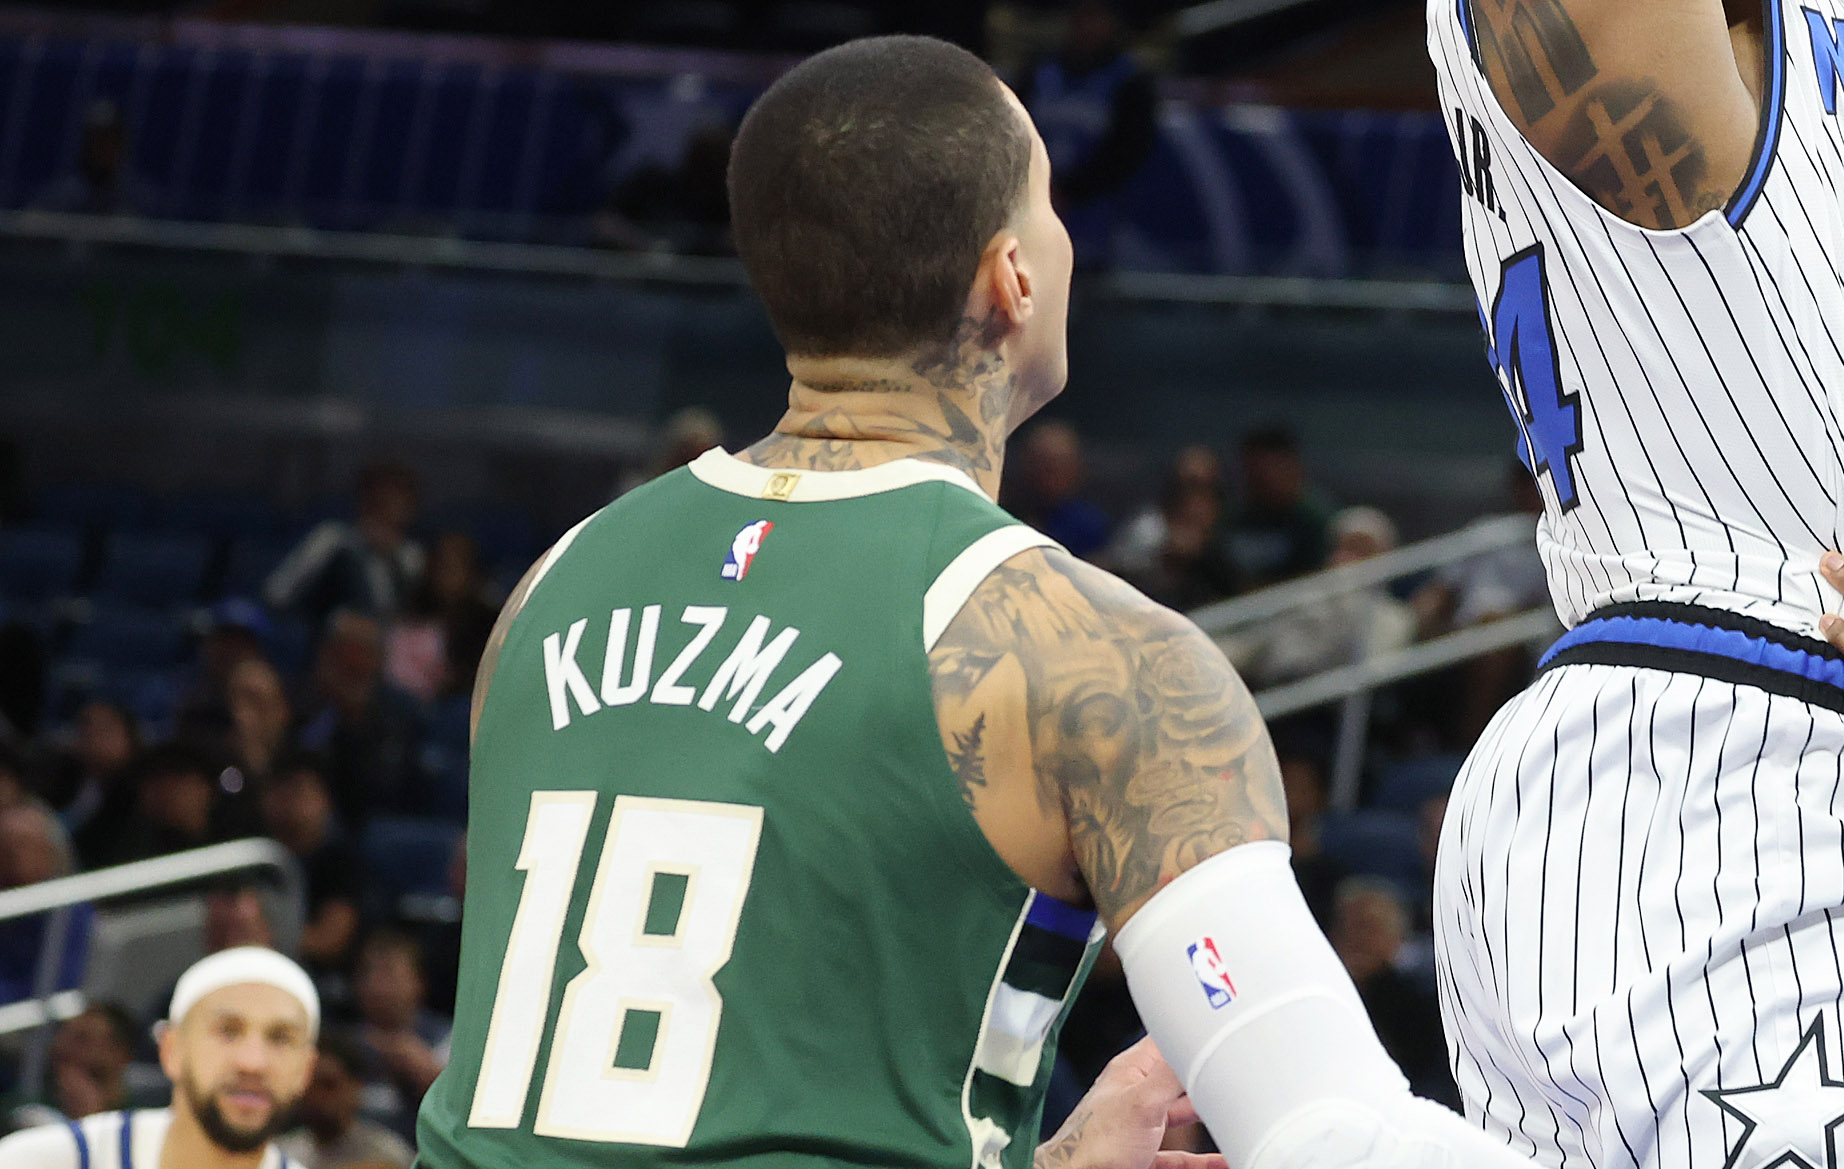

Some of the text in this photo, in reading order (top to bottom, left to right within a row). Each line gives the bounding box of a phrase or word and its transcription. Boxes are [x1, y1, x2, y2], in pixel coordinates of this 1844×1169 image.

[1475, 240, 1584, 516] 4
[542, 604, 843, 754] KUZMA
[466, 789, 765, 1149] 18
